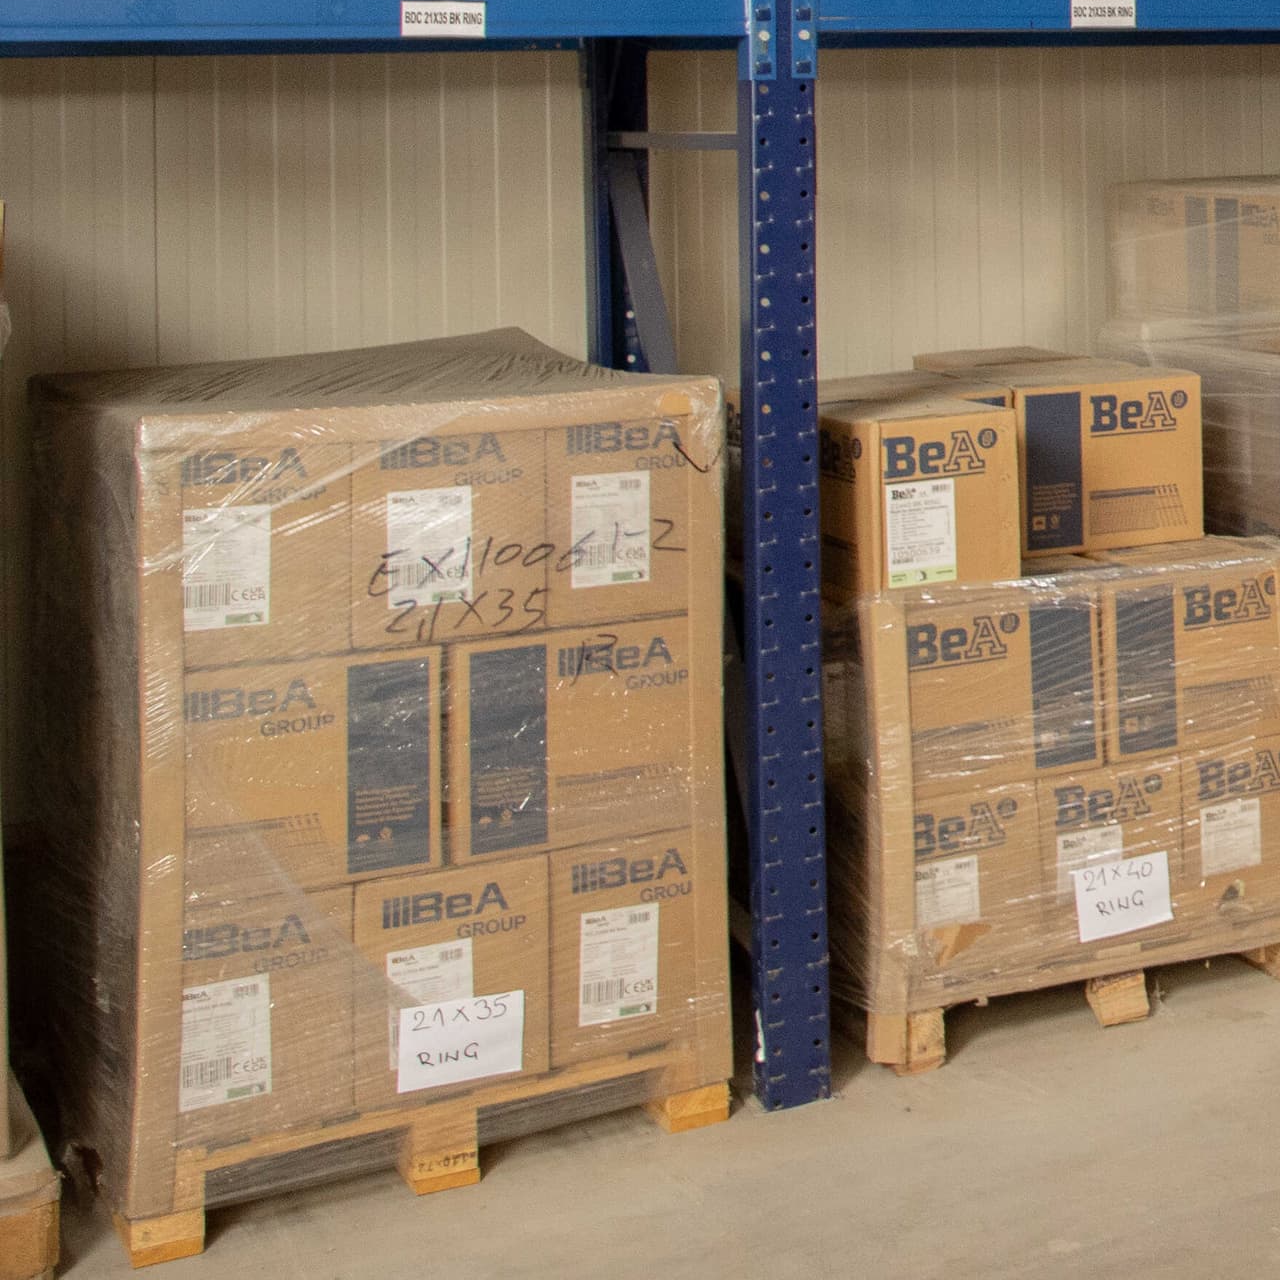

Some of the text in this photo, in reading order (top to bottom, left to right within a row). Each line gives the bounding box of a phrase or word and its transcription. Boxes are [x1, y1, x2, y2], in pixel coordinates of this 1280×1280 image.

[405, 12, 482, 25] BDC 21X35 BK RING
[1118, 6, 1133, 17] RING
[1090, 392, 1178, 432] BeA
[636, 455, 687, 471] GROU
[883, 430, 988, 479] BeA
[455, 469, 523, 486] GROUP
[626, 670, 688, 690] GROUP
[261, 714, 334, 736] GROUP
[641, 882, 692, 902] GROU
[1097, 890, 1144, 916] RING
[457, 915, 526, 938] GROUP
[416, 1043, 479, 1066] RING
